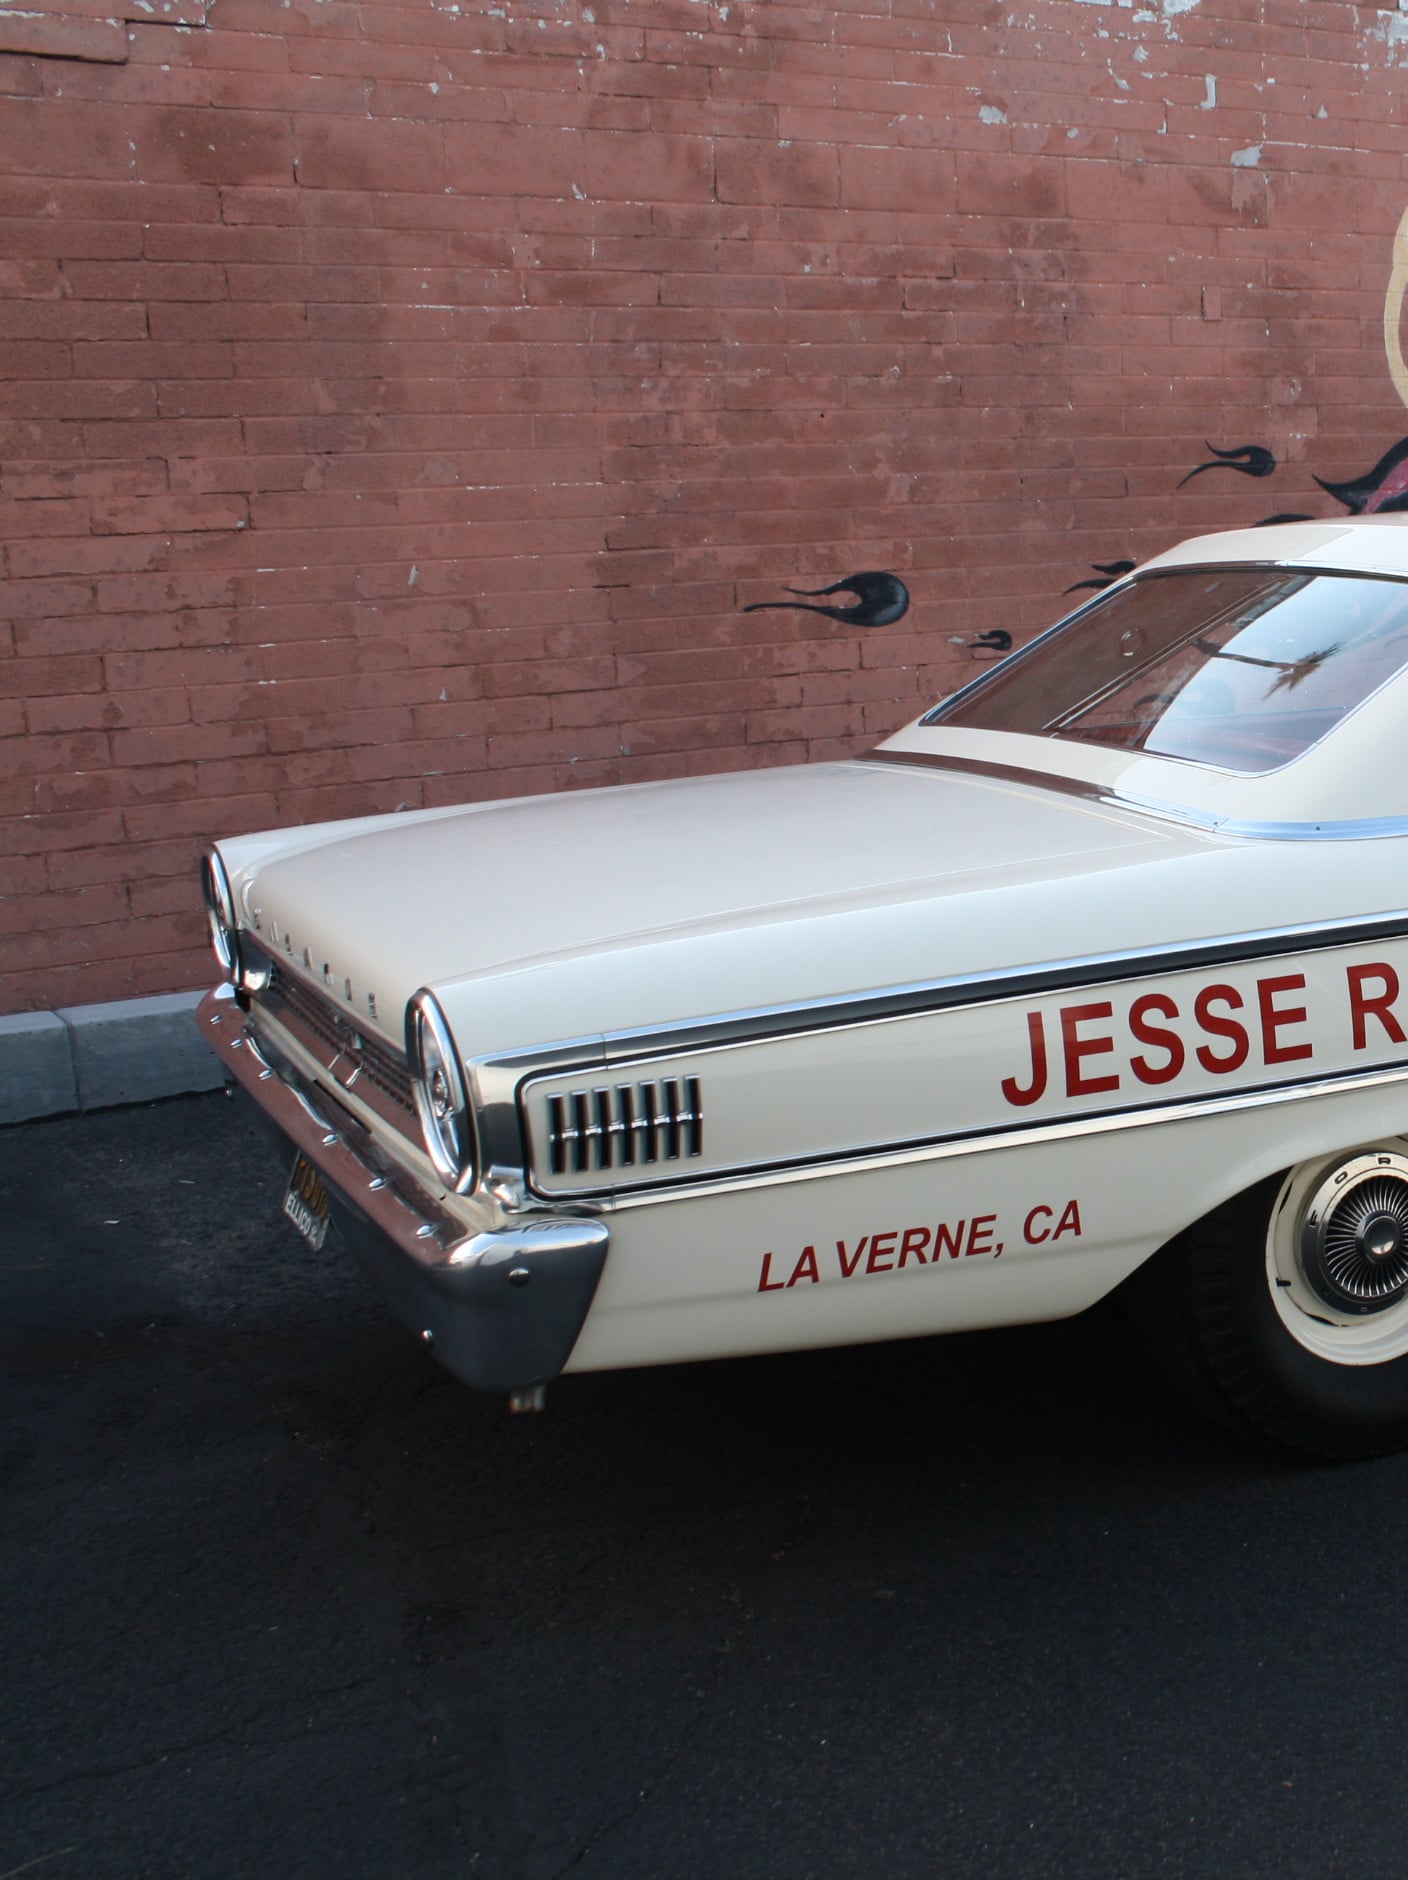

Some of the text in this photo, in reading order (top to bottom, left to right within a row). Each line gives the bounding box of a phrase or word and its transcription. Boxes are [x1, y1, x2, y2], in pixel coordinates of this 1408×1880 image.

[1000, 972, 1314, 1107] JESSE
[284, 1192, 312, 1236] ELLICO
[758, 1199, 1082, 1293] LA VERNE, CA
